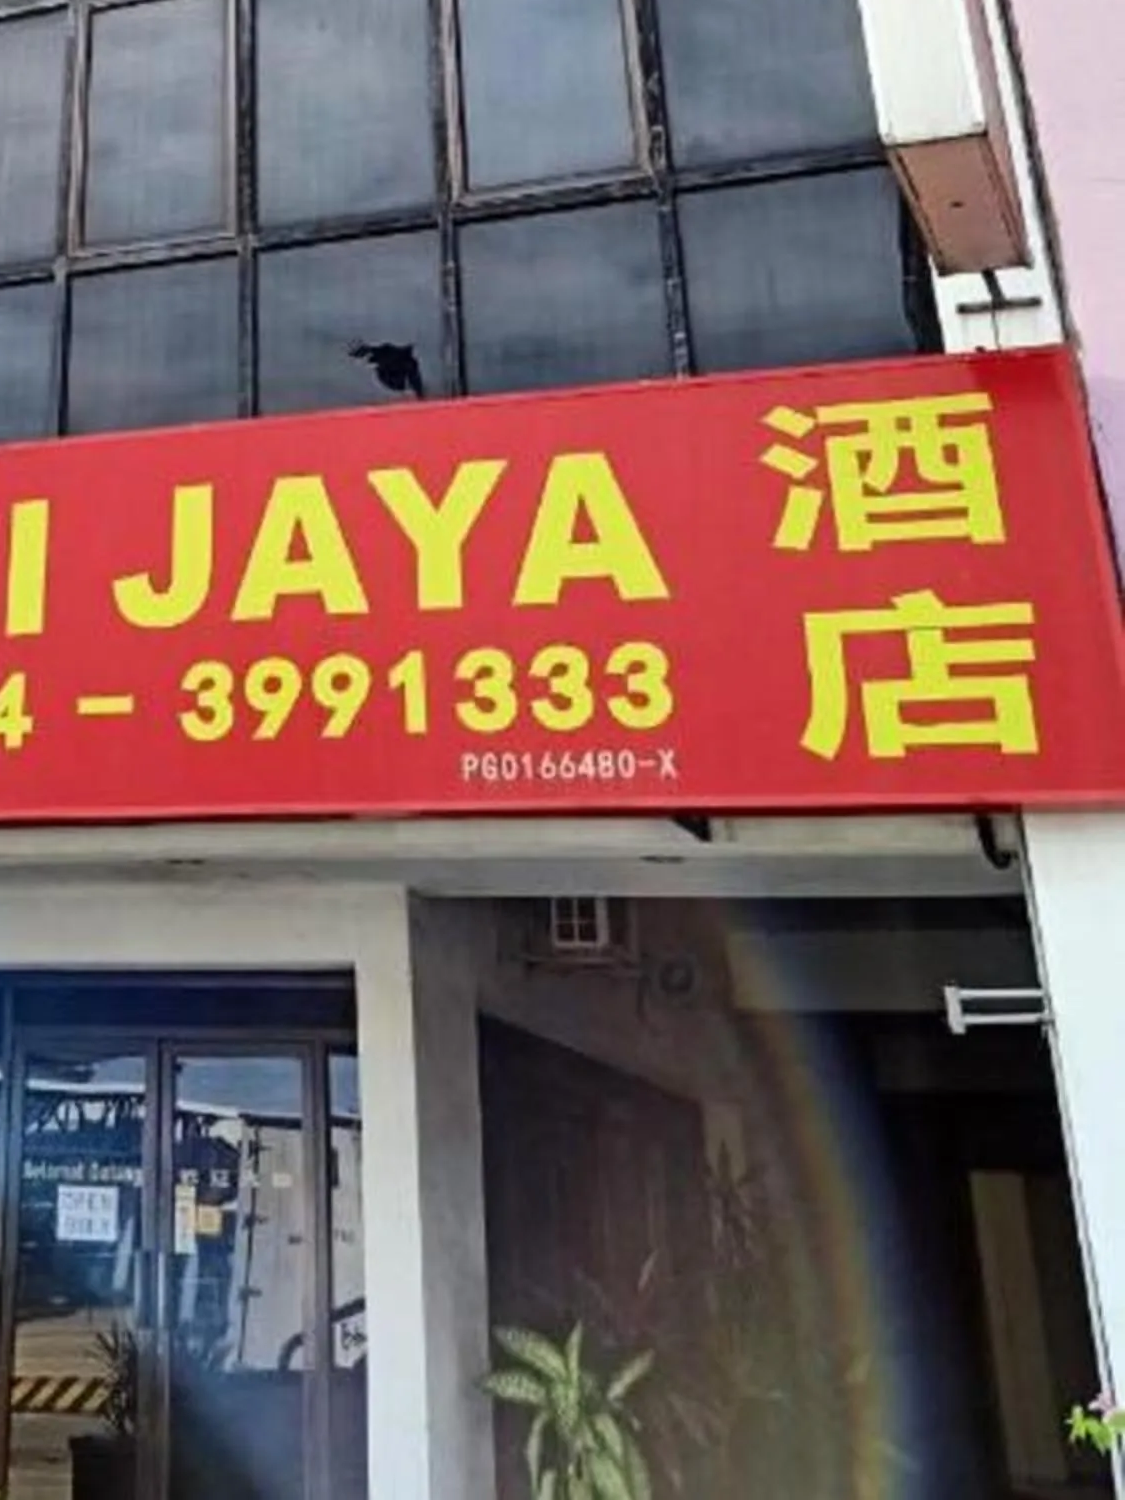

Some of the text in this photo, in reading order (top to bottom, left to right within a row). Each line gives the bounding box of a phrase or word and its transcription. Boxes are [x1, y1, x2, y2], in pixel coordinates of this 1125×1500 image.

[113, 452, 670, 628] JAYA
[760, 392, 1039, 760] 酒店
[180, 641, 673, 742] 3991333
